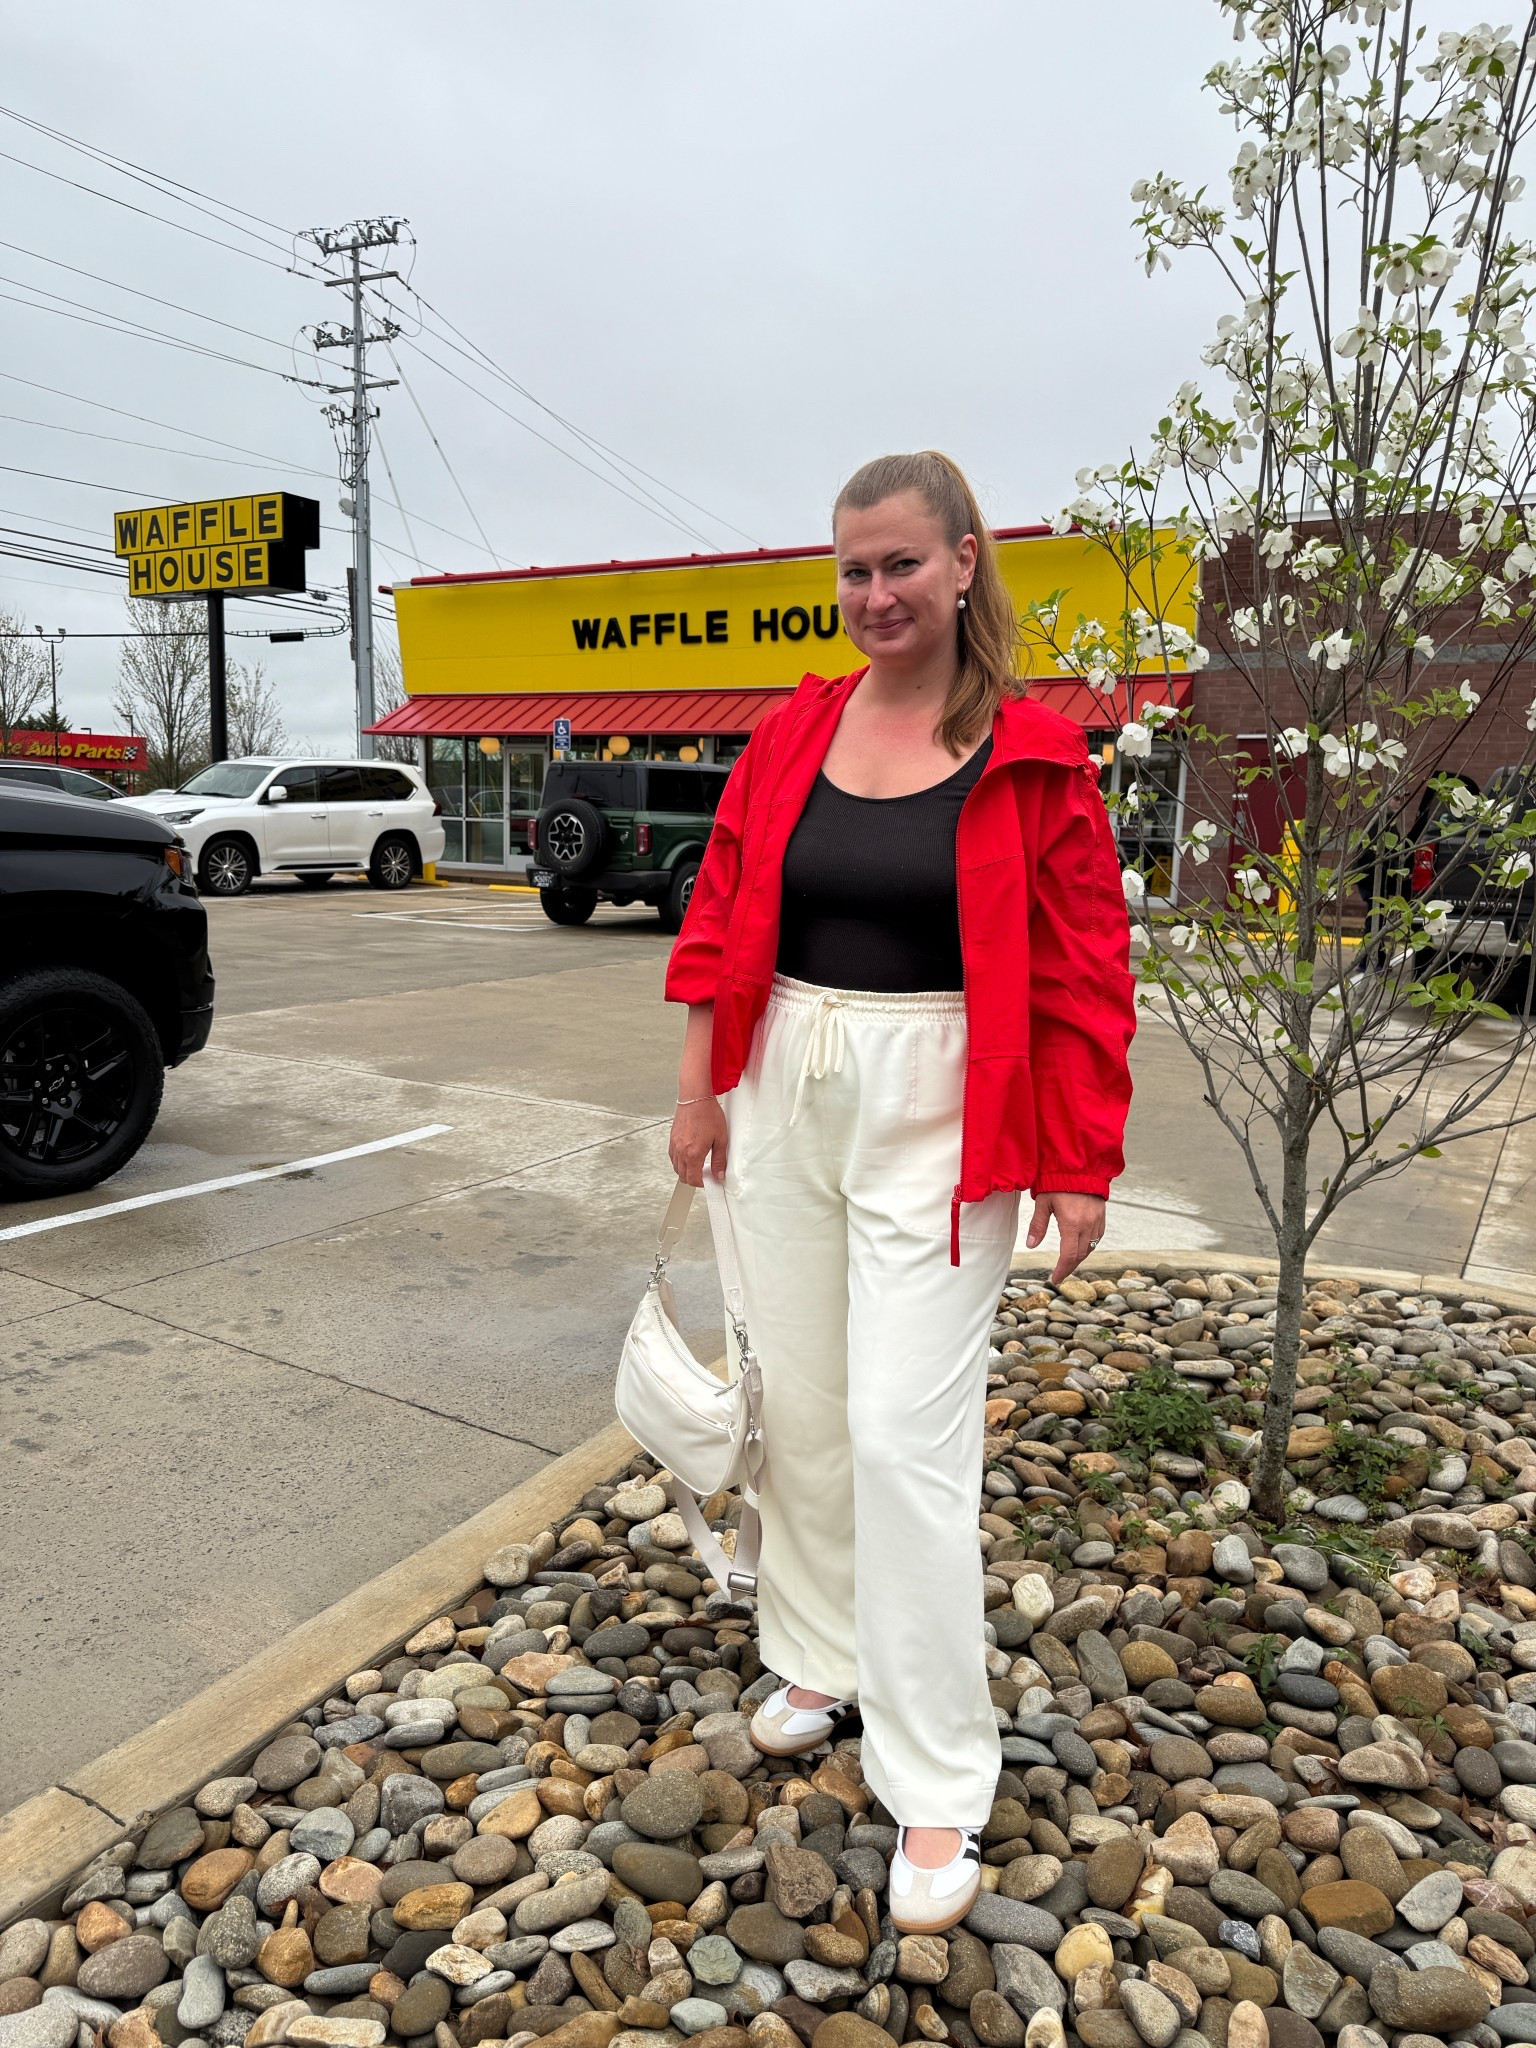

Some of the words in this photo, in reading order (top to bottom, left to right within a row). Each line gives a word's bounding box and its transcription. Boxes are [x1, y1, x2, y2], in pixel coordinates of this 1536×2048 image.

[118, 500, 278, 550] WAFFLE
[133, 547, 263, 590] HOUSE
[572, 609, 729, 650] WAFFLE
[753, 603, 846, 643] HOU
[25, 741, 73, 757] Auto
[74, 743, 122, 759] Parts
